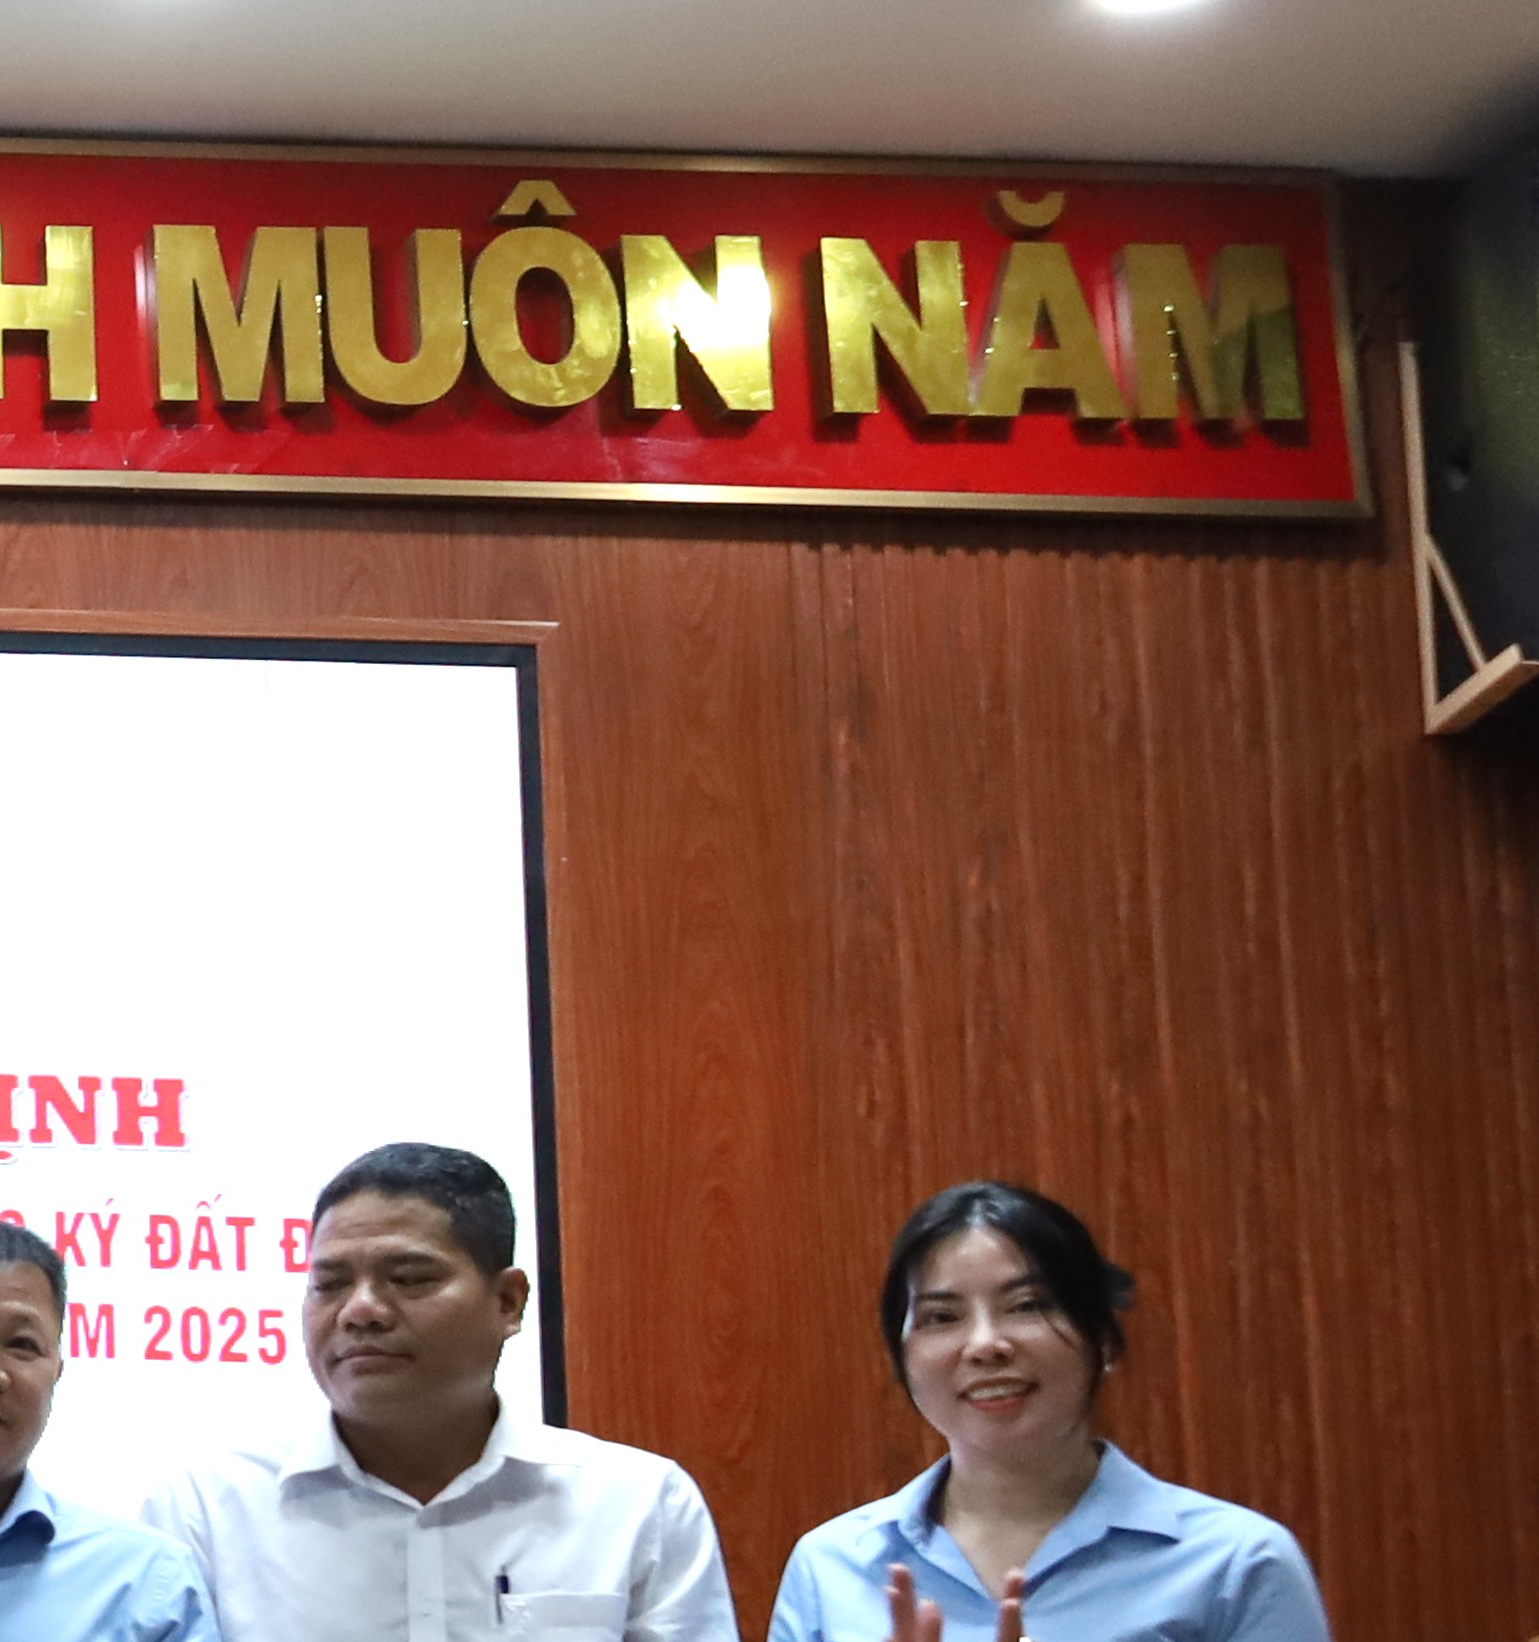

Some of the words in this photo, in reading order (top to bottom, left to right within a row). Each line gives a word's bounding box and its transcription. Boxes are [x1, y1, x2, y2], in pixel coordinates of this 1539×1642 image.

[150, 178, 775, 413] MUÔN
[820, 190, 1306, 420] NĂM
[55, 1198, 121, 1268] KÝ
[145, 1193, 256, 1272] ĐẤT
[144, 1306, 286, 1365] 2025
